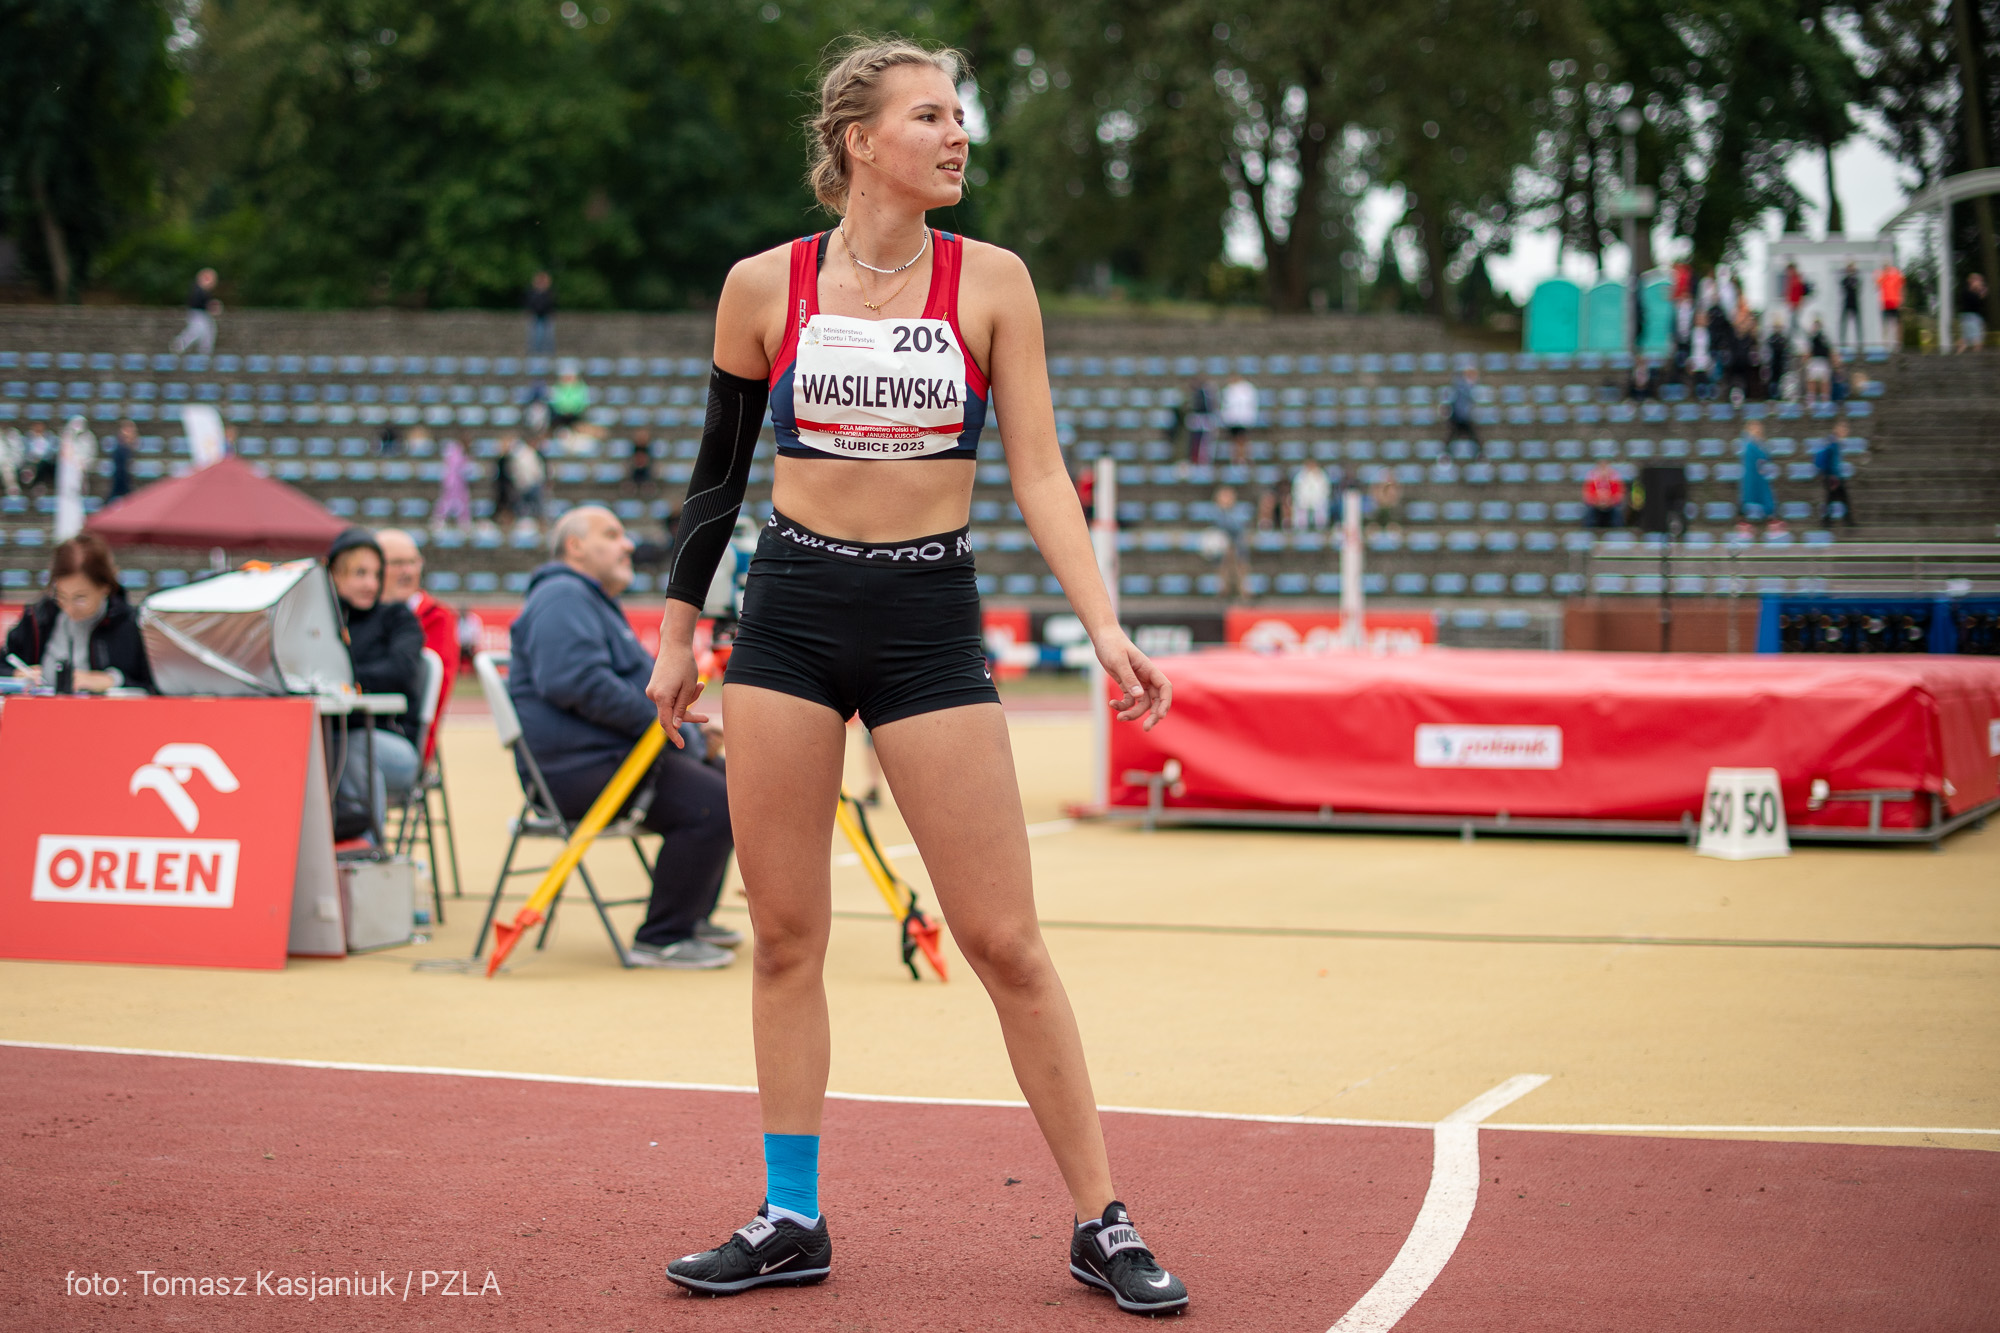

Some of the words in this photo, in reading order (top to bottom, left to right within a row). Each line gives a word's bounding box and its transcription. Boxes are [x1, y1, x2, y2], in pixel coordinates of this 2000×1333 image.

[823, 327, 863, 336] Ministerstwo
[848, 336, 876, 344] Turystyki
[801, 374, 958, 410] WASILEWSKA
[833, 437, 889, 453] SŁUBICE
[892, 441, 925, 453] 2023
[780, 527, 865, 557] NIKE
[865, 541, 946, 562] PRO
[1707, 790, 1734, 833] 50
[1743, 790, 1778, 834] 50
[48, 848, 222, 894] ORLEN
[1107, 1228, 1141, 1249] NIKE
